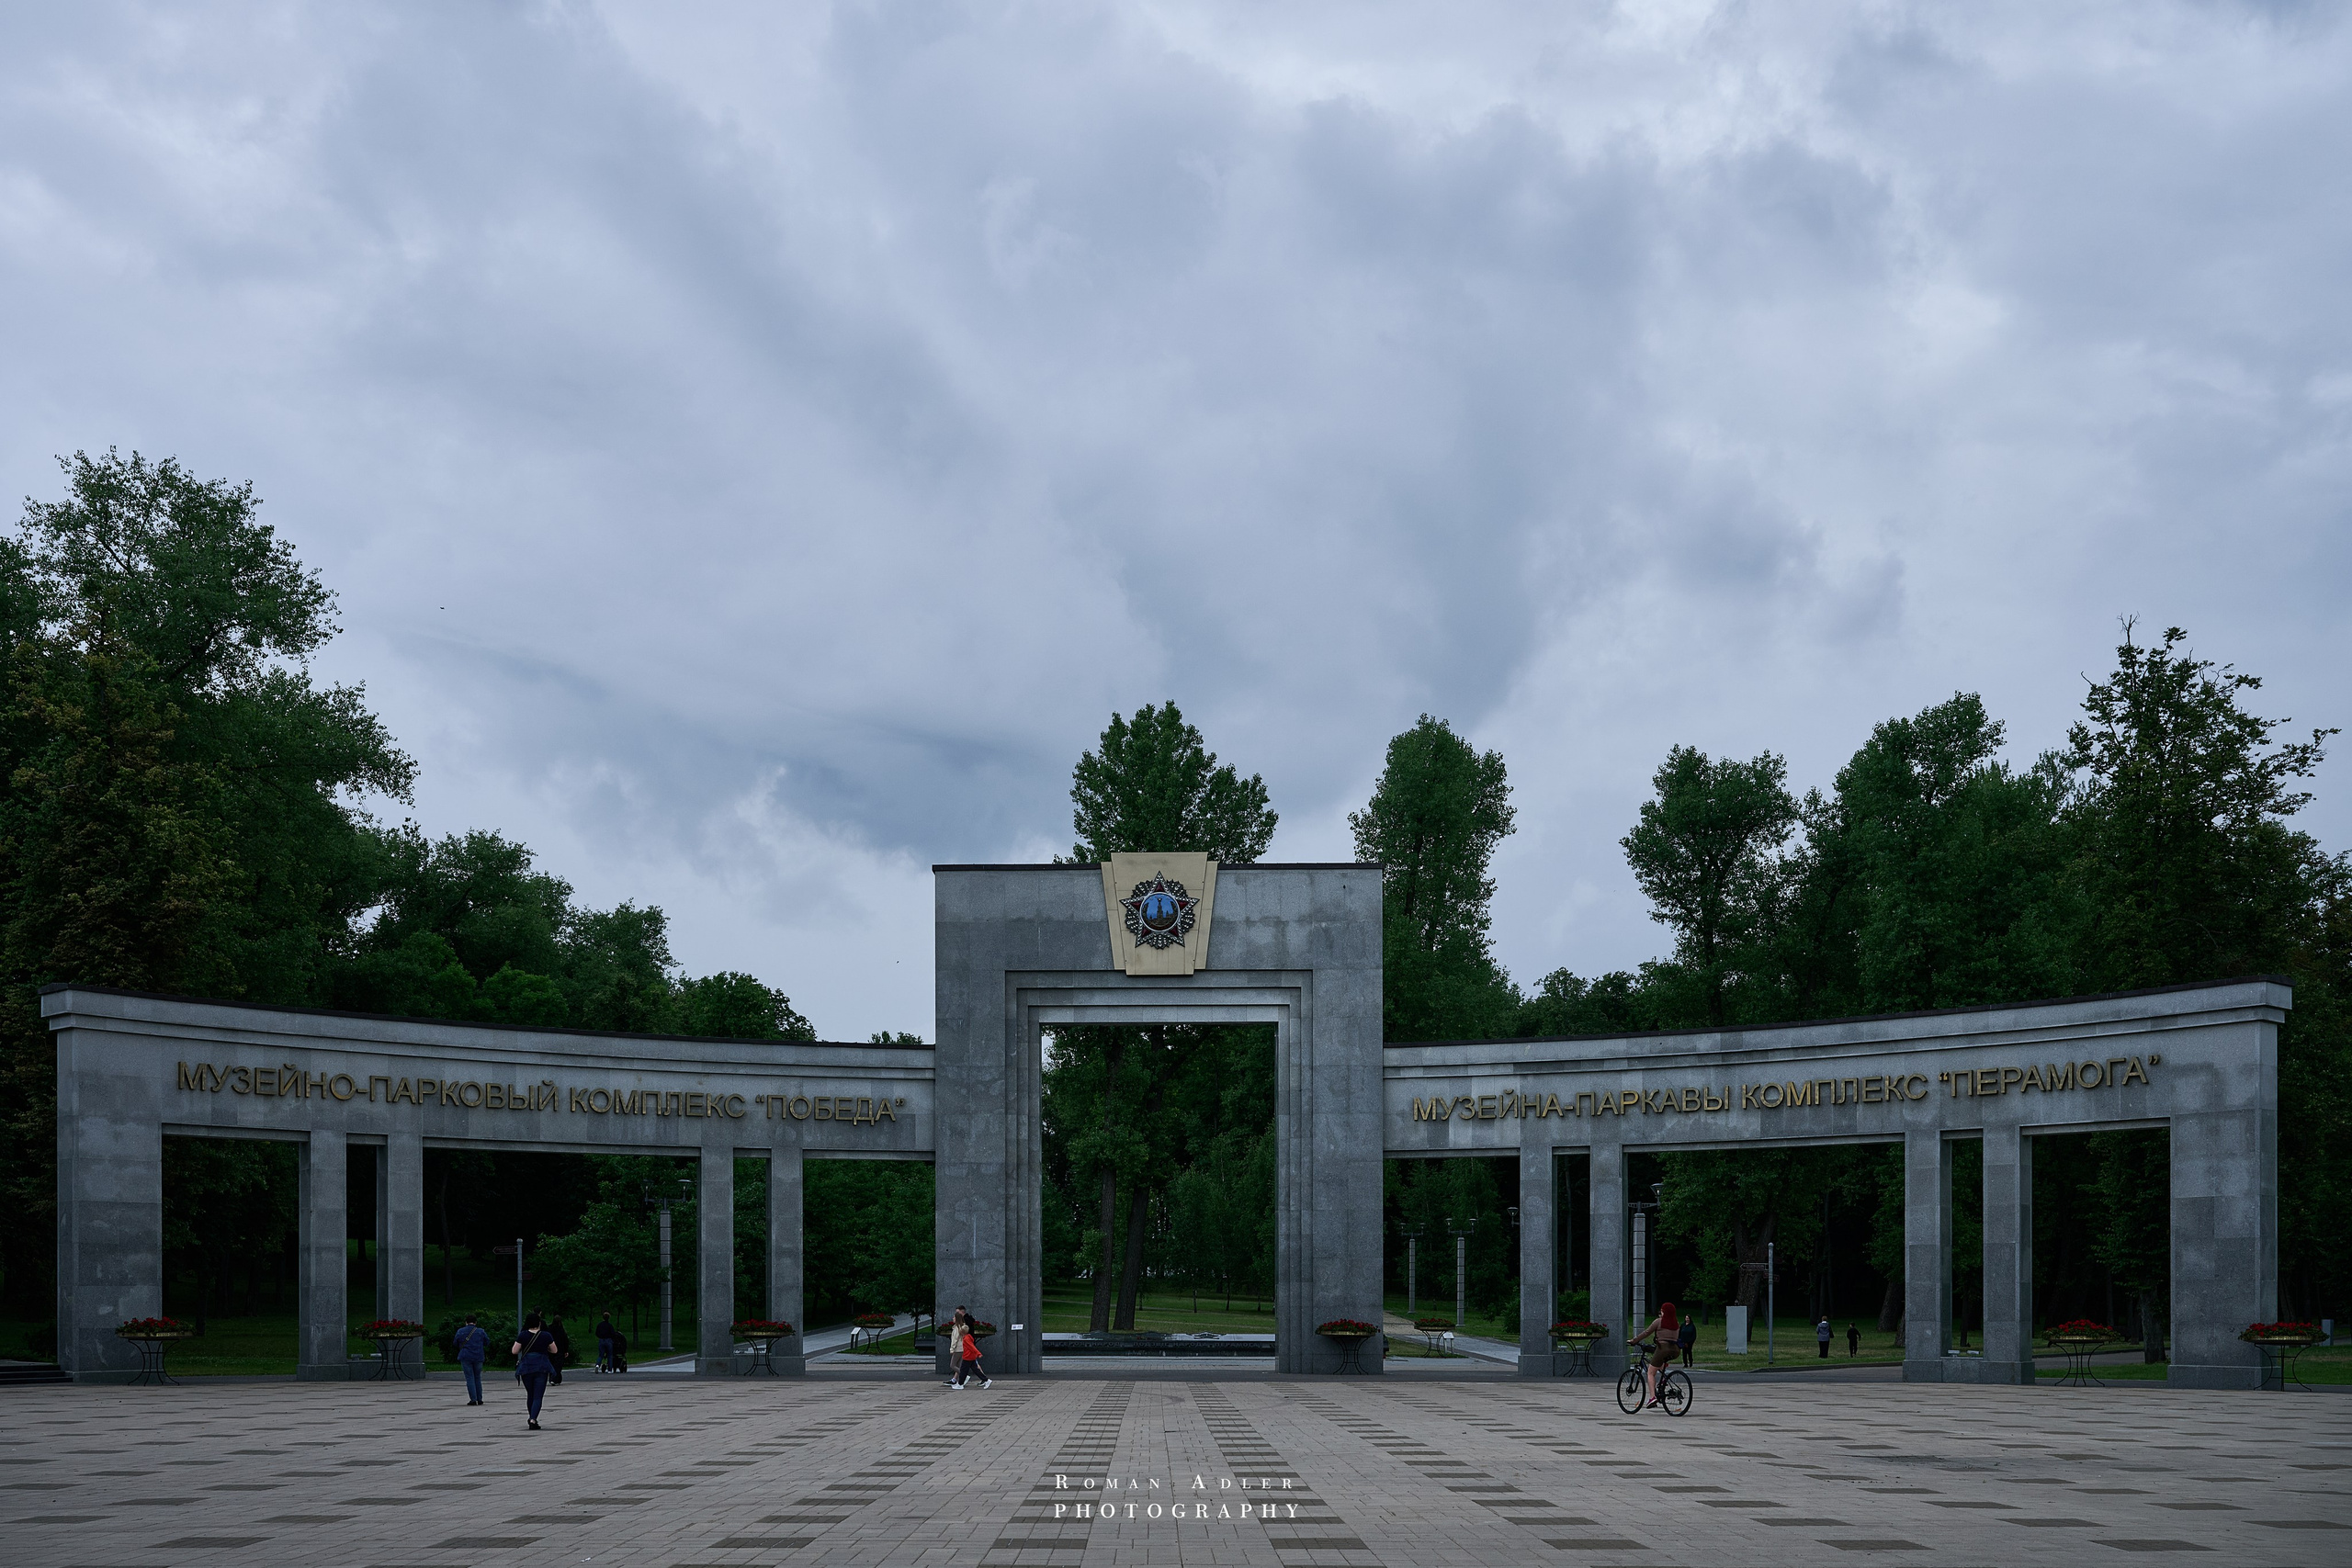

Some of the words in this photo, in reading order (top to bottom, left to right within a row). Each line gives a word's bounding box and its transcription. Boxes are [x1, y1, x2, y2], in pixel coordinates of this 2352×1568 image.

[177, 1060, 560, 1112] МУЗЕЙНО-ПАРКОВЫЙ
[570, 1087, 746, 1118] КОМПЛЕКС
[1412, 1084, 1730, 1122] МУЗЕЙНА-ПАРКАВЫ
[1741, 1073, 1928, 1109] КОМПЛЕКС
